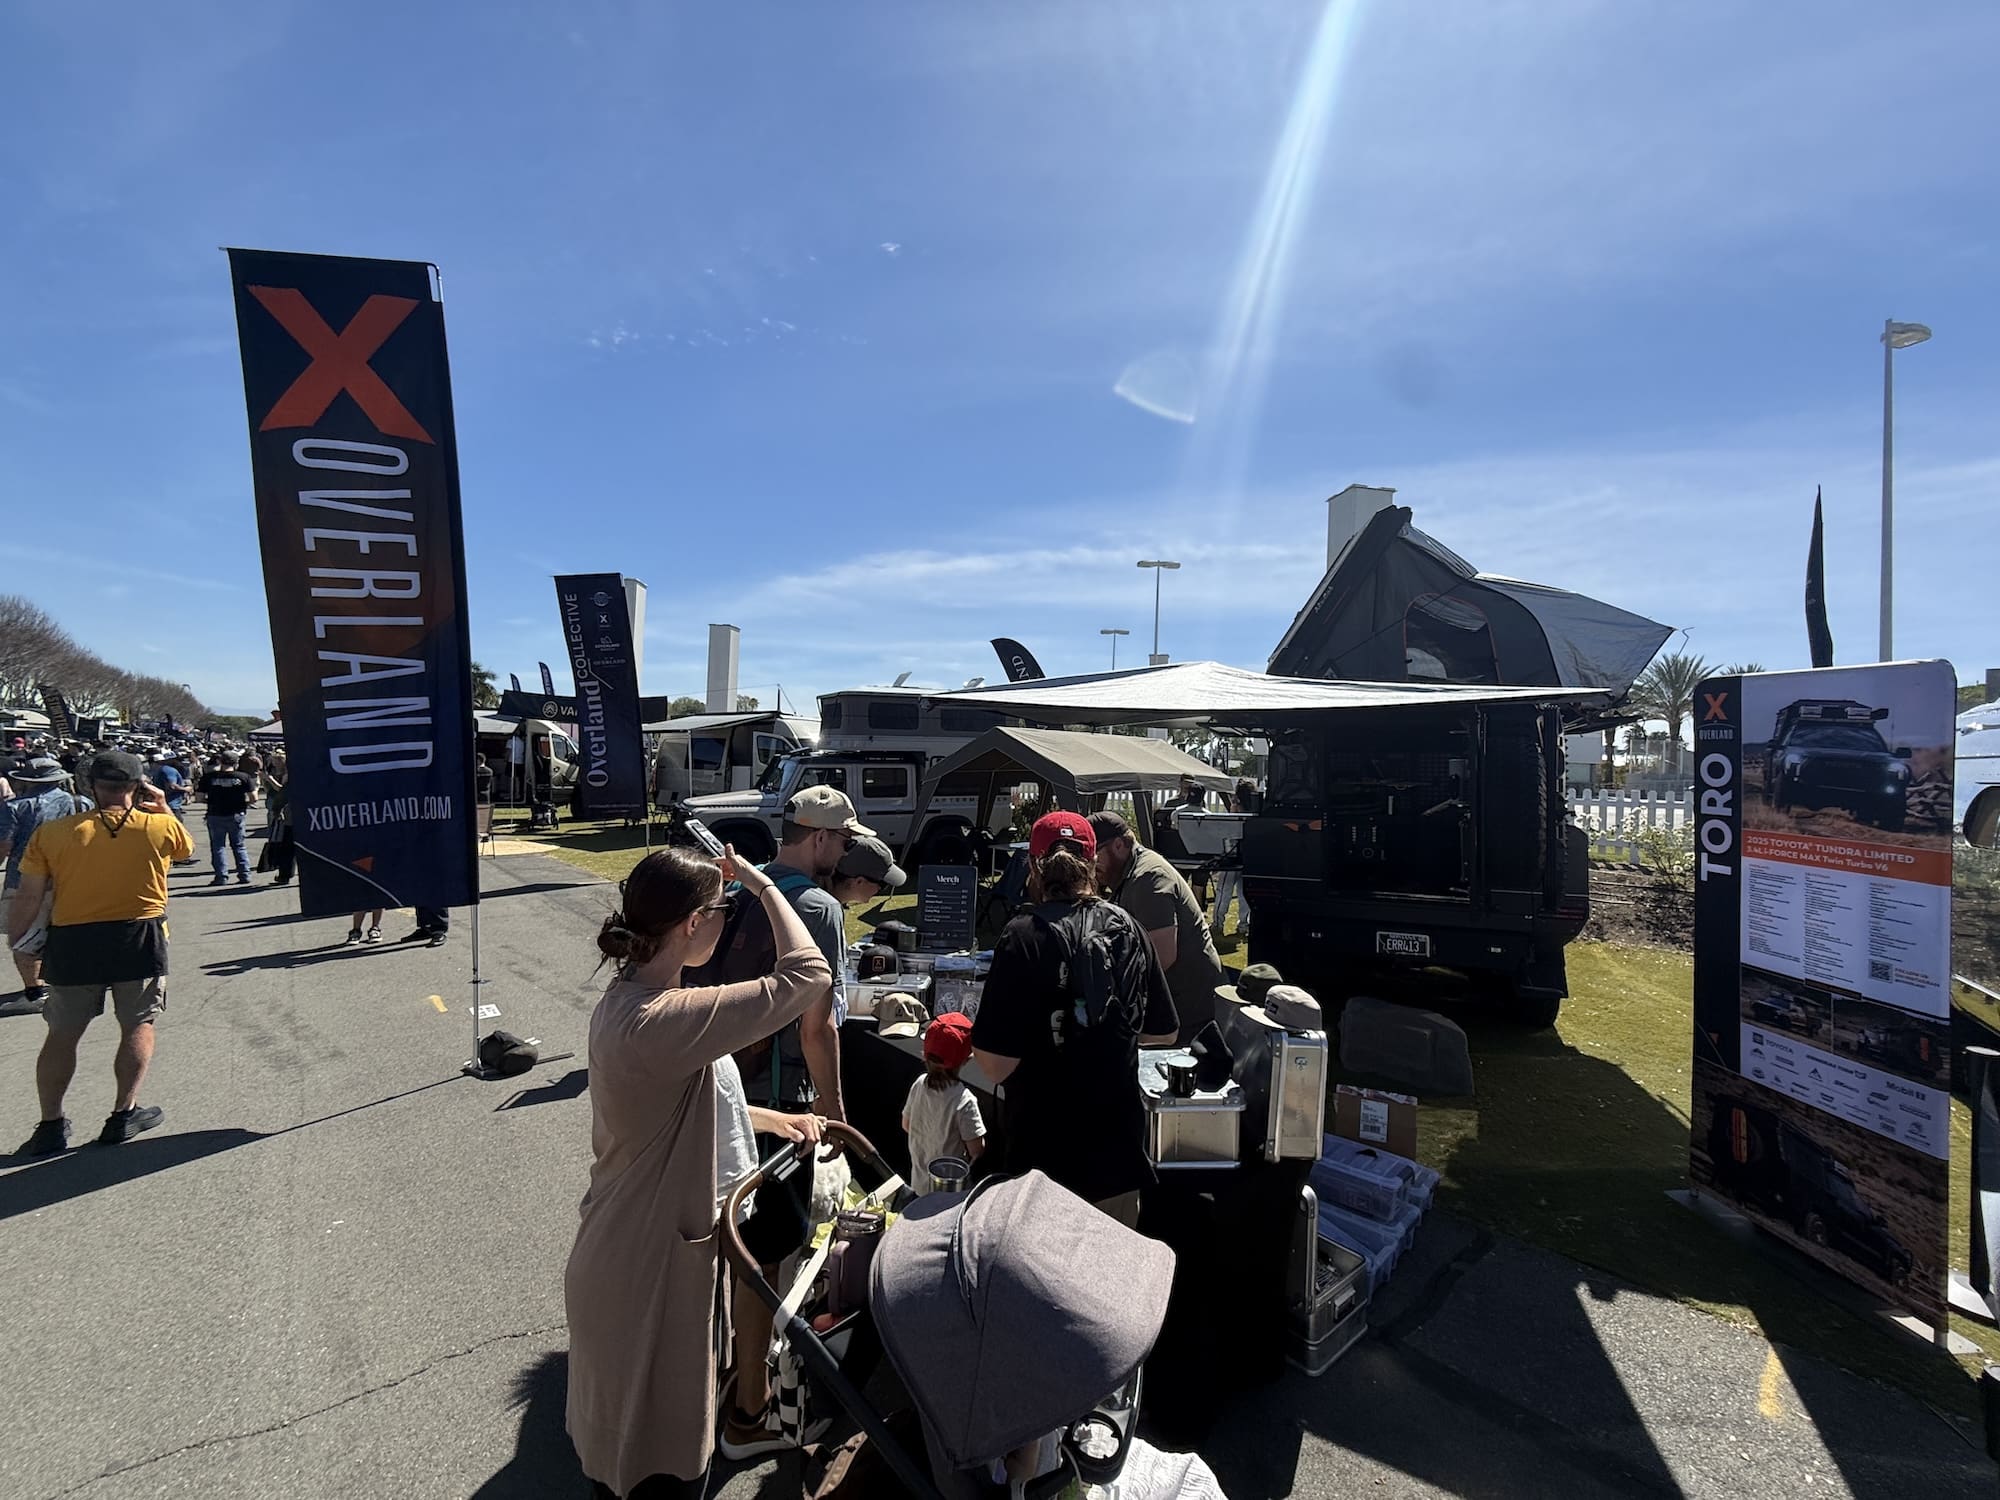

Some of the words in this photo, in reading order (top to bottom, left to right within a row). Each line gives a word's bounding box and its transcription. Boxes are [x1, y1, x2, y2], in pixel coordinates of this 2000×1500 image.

[248, 284, 437, 444] X
[291, 437, 433, 774] OVERLAND
[564, 593, 588, 679] COLLECTIVE
[1703, 692, 1729, 721] X
[579, 680, 609, 788] Overland
[1699, 728, 1734, 740] OVERLAND
[308, 795, 452, 833] XOVERLAND.COM
[1699, 752, 1733, 882] TORO
[1747, 836, 1769, 846] 2025
[1816, 844, 1862, 857] TUNDRA
[1864, 850, 1915, 864] LIMITED
[1800, 853, 1821, 863] MAX
[1822, 855, 1844, 865] Twin
[1845, 858, 1873, 869] Turbo
[1874, 862, 1889, 872] V6
[936, 874, 960, 884] Merch
